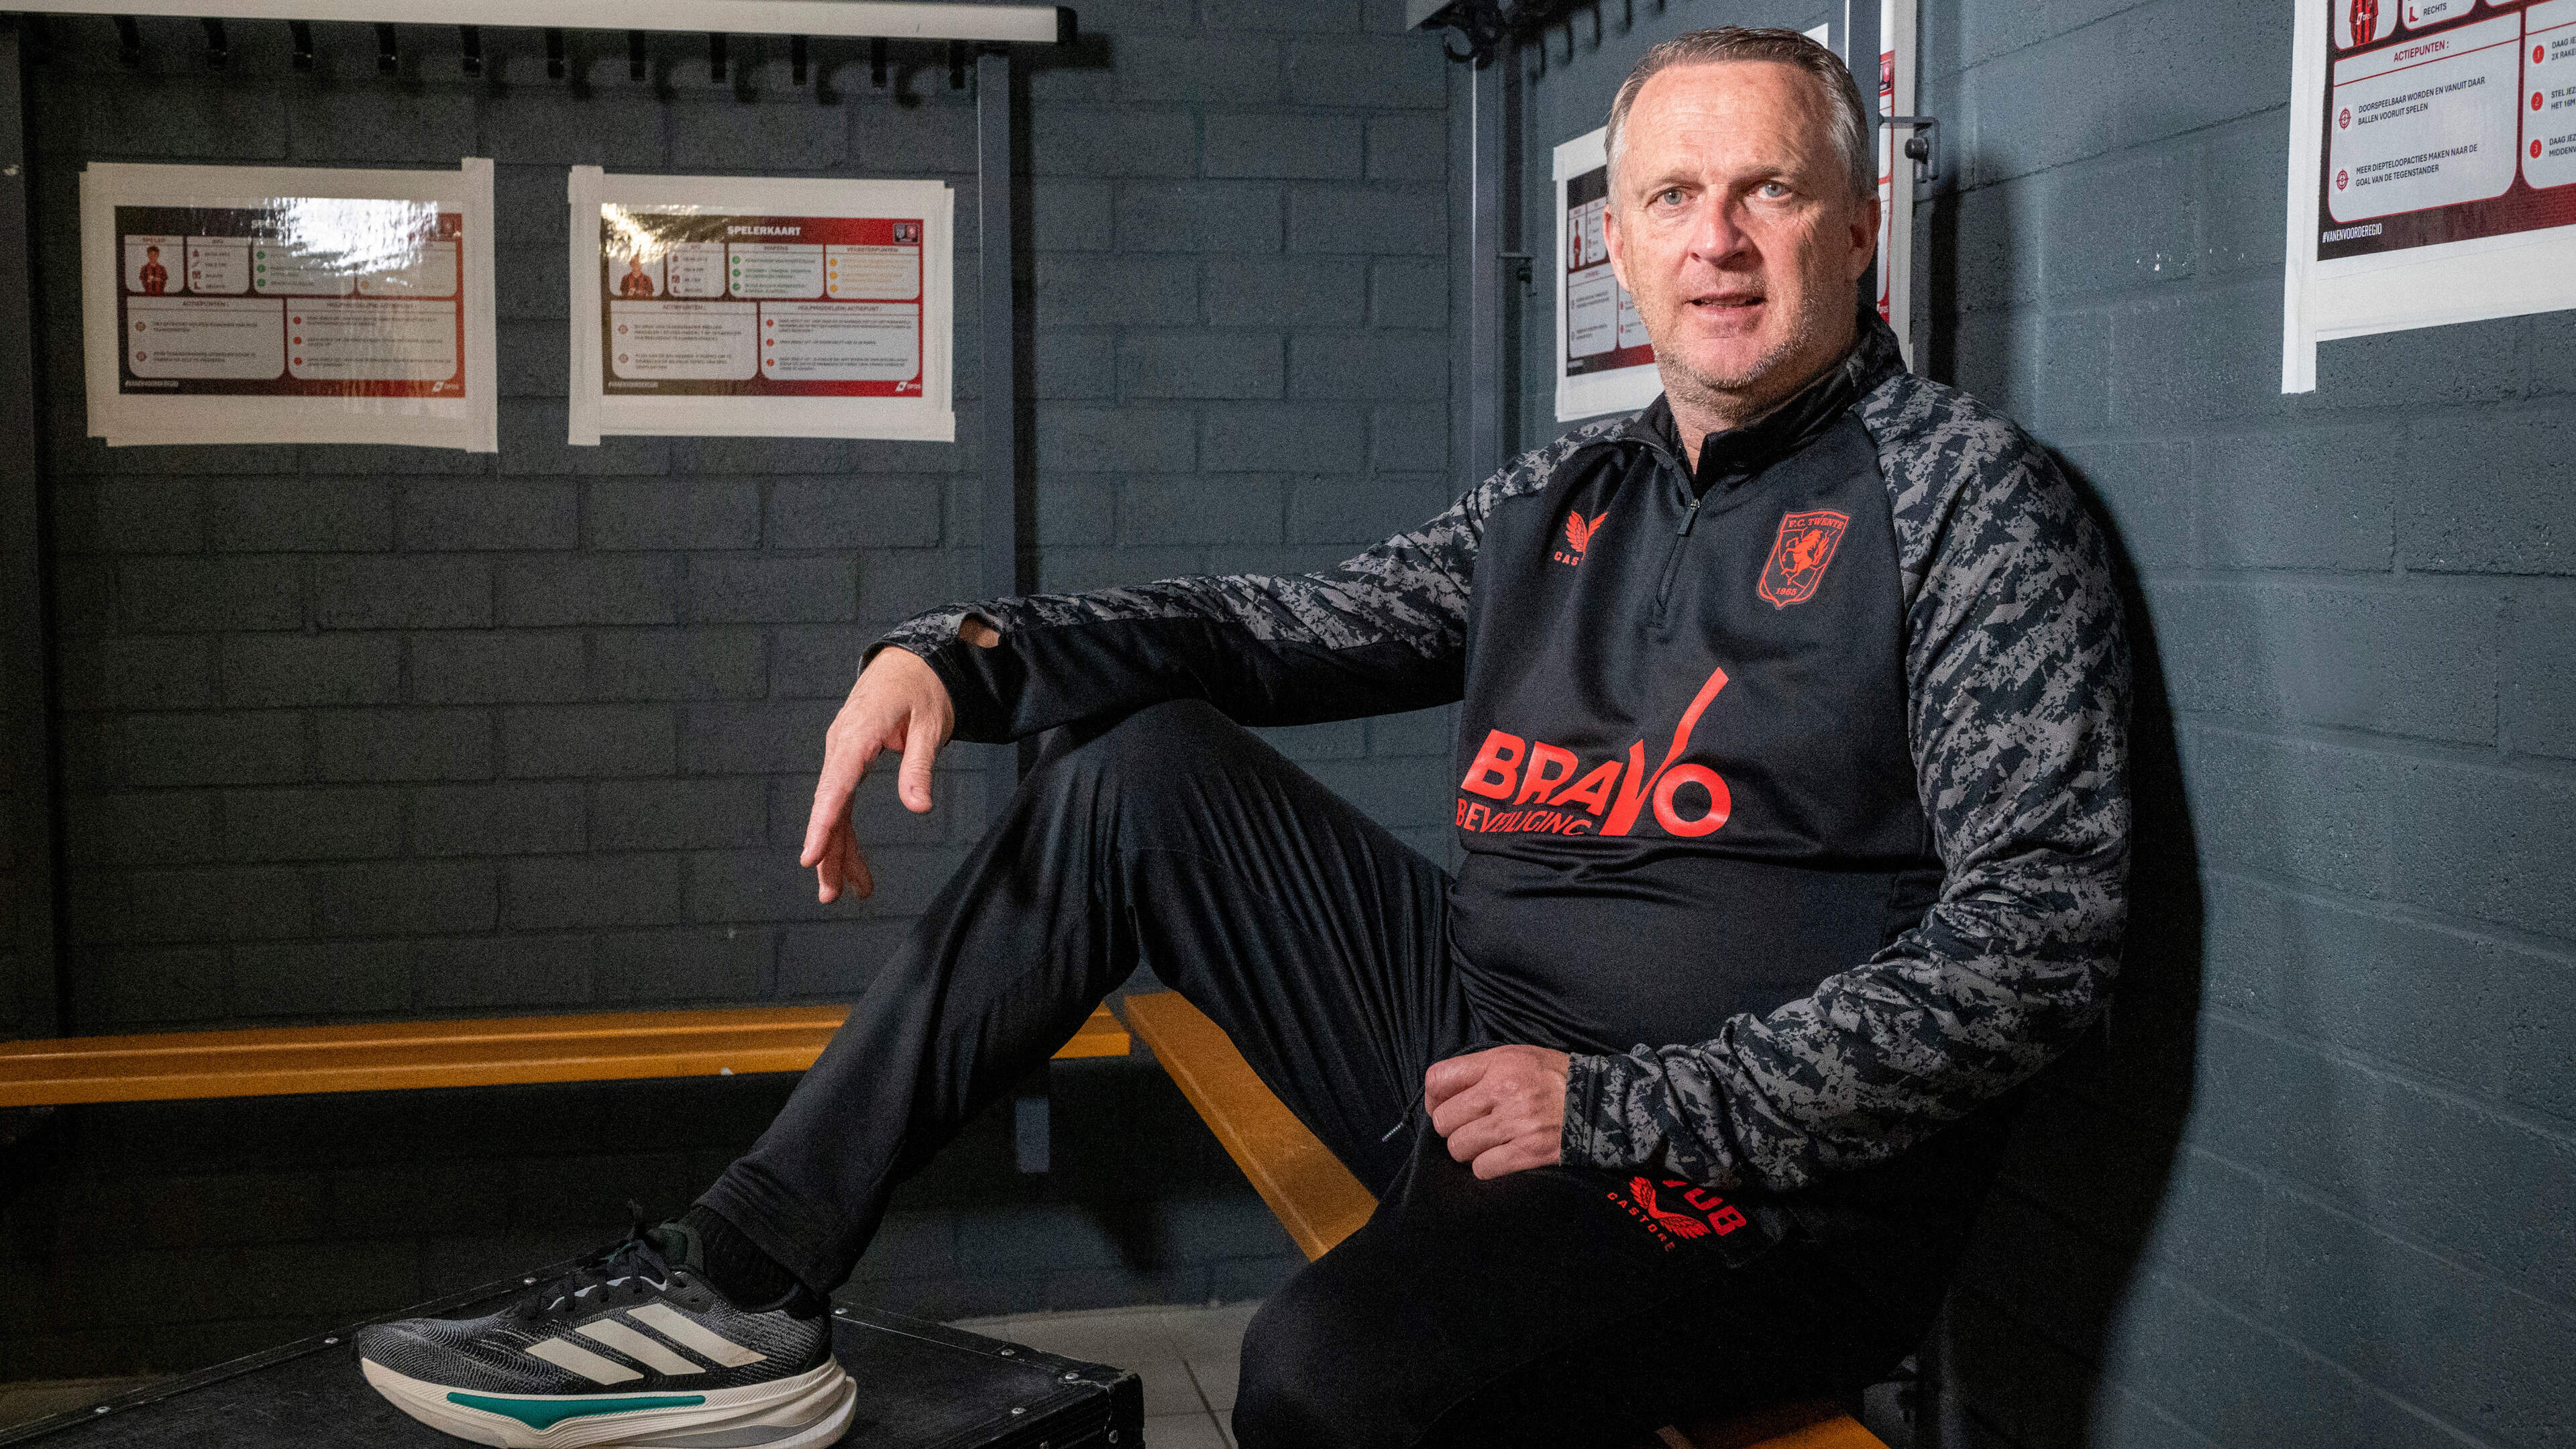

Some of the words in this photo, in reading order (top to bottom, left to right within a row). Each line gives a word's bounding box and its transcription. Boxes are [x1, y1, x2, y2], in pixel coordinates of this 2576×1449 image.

[2423, 2, 2447, 16] RECHTS
[2394, 41, 2445, 62] ACTIEPUNTEN
[2552, 38, 2569, 48] DAAG
[2551, 52, 2559, 60] 2X
[2359, 95, 2406, 113] DOORSPEELBAAR
[2407, 89, 2434, 101] WORDEN
[2435, 86, 2443, 96] EN
[2445, 80, 2467, 93] VANUIT
[2468, 76, 2485, 87] DAAR
[2551, 89, 2565, 98] STEL
[2551, 101, 2563, 109] HET
[2565, 99, 2576, 107] 16M
[2358, 114, 2378, 125] BALLEN
[2379, 107, 2405, 120] VOORUIT
[2406, 102, 2428, 115] SPELEN
[2549, 136, 2565, 145] DAAG
[2356, 165, 2371, 175] MEER
[2373, 154, 2428, 172] DIEPTELOOPACTIES
[2428, 149, 2450, 161] MAKEN
[2451, 145, 2468, 156] NAAR
[2469, 144, 2478, 153] DE
[2356, 178, 2371, 187] GOAL
[2372, 175, 2383, 184] VAN
[2394, 164, 2439, 180] TEGENSTANDER
[727, 225, 801, 236] SPELERKAART
[2322, 223, 2382, 243] #VANENVOORDEREGIO
[1807, 517, 1844, 530] TWENTE
[1776, 587, 1798, 596] 1965
[1460, 666, 1731, 838] BRAVO
[1662, 1179, 1747, 1236] UB
[1607, 1191, 1675, 1252] CASTORE
